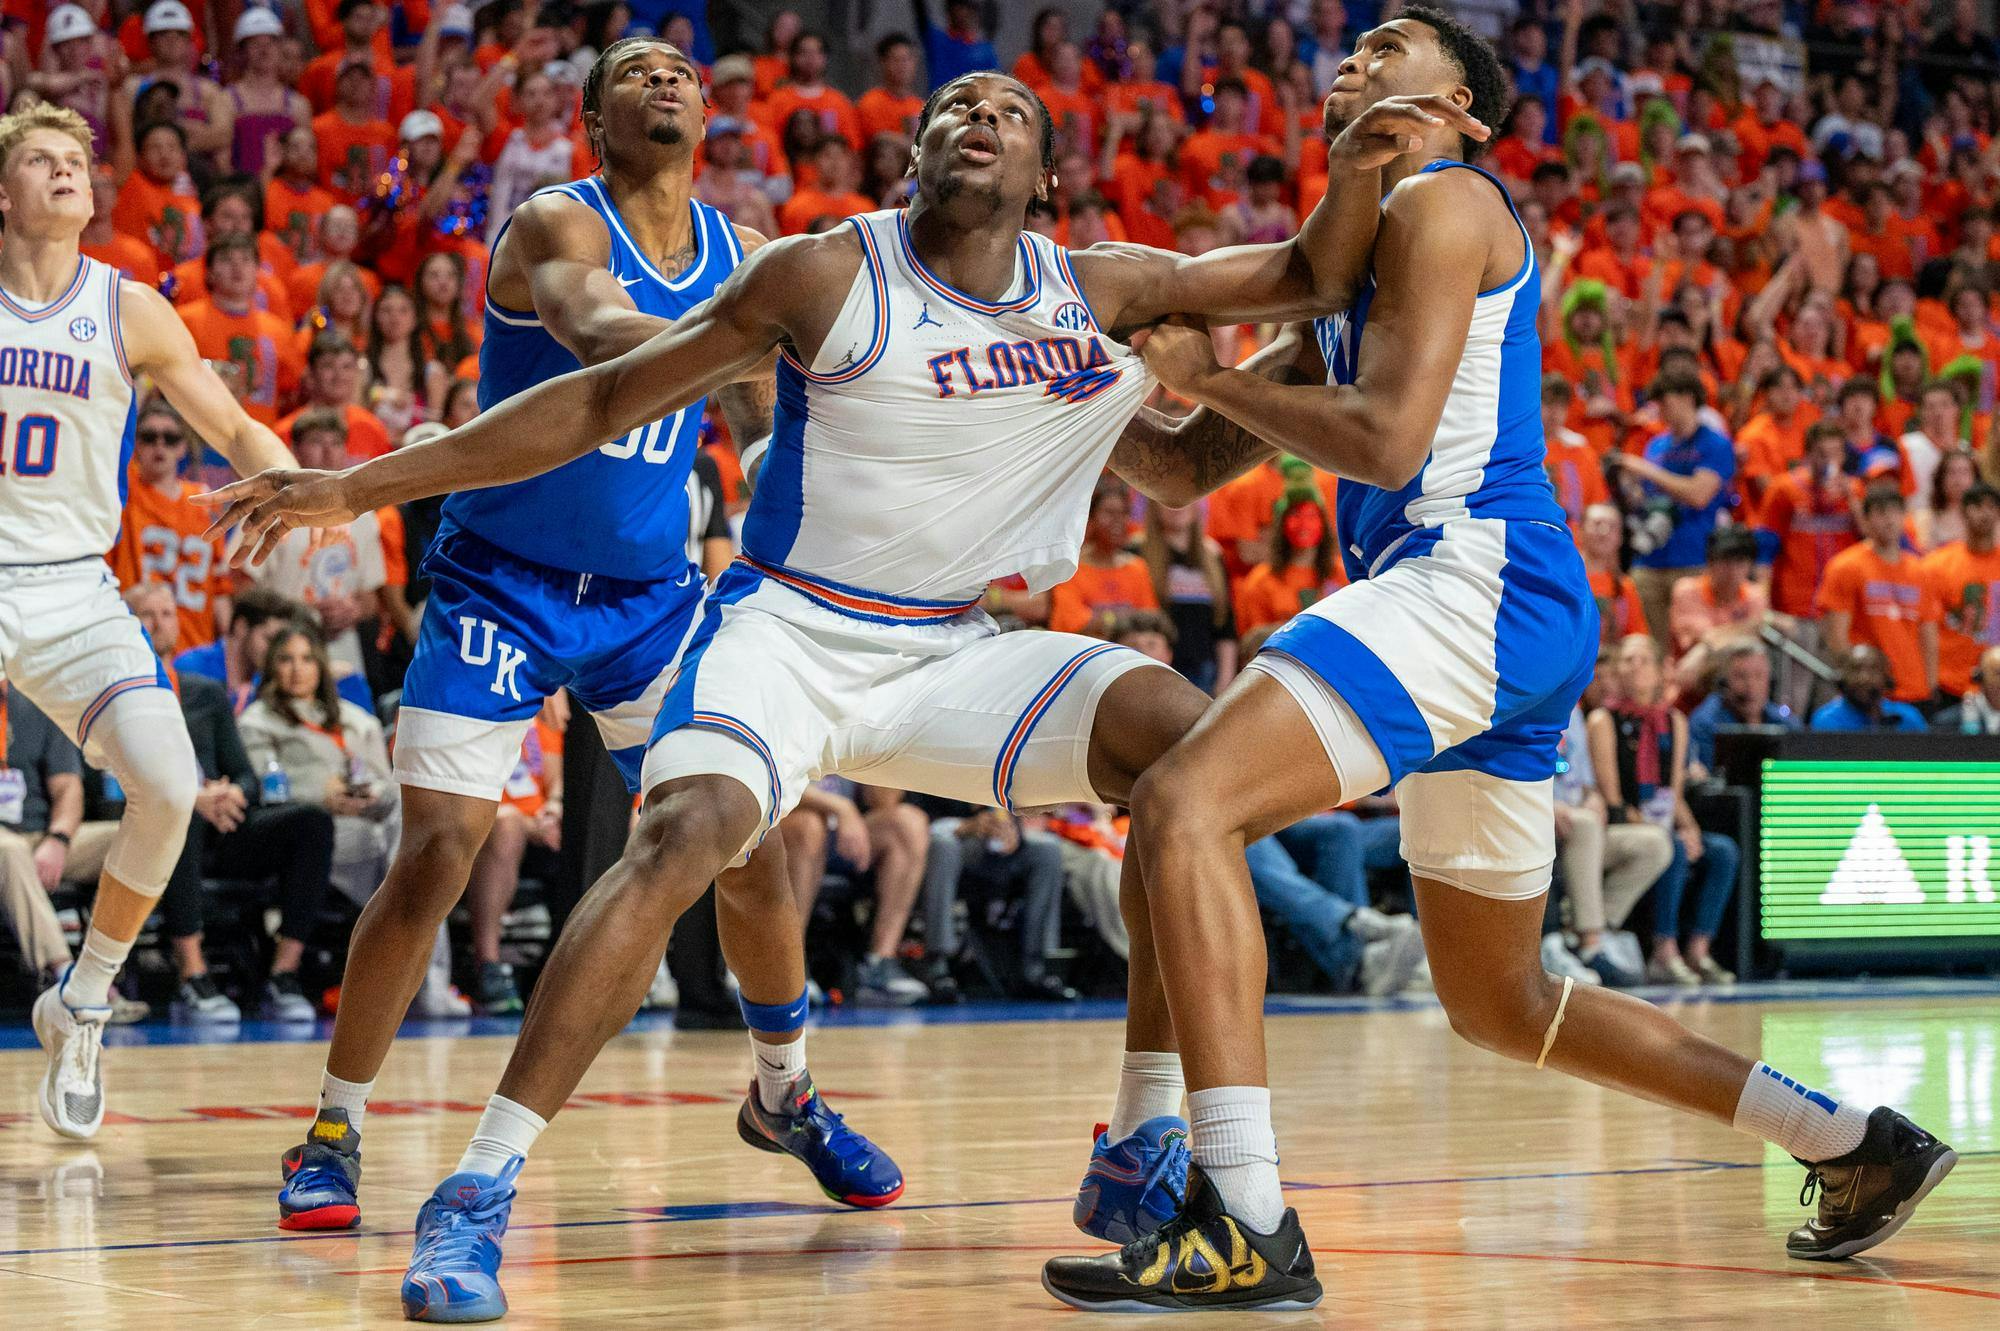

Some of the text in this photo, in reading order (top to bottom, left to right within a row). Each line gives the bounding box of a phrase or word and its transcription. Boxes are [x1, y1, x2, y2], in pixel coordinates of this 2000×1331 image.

[70, 317, 96, 341] SEC
[928, 335, 1113, 398] FLORIDA
[459, 616, 527, 702] UK
